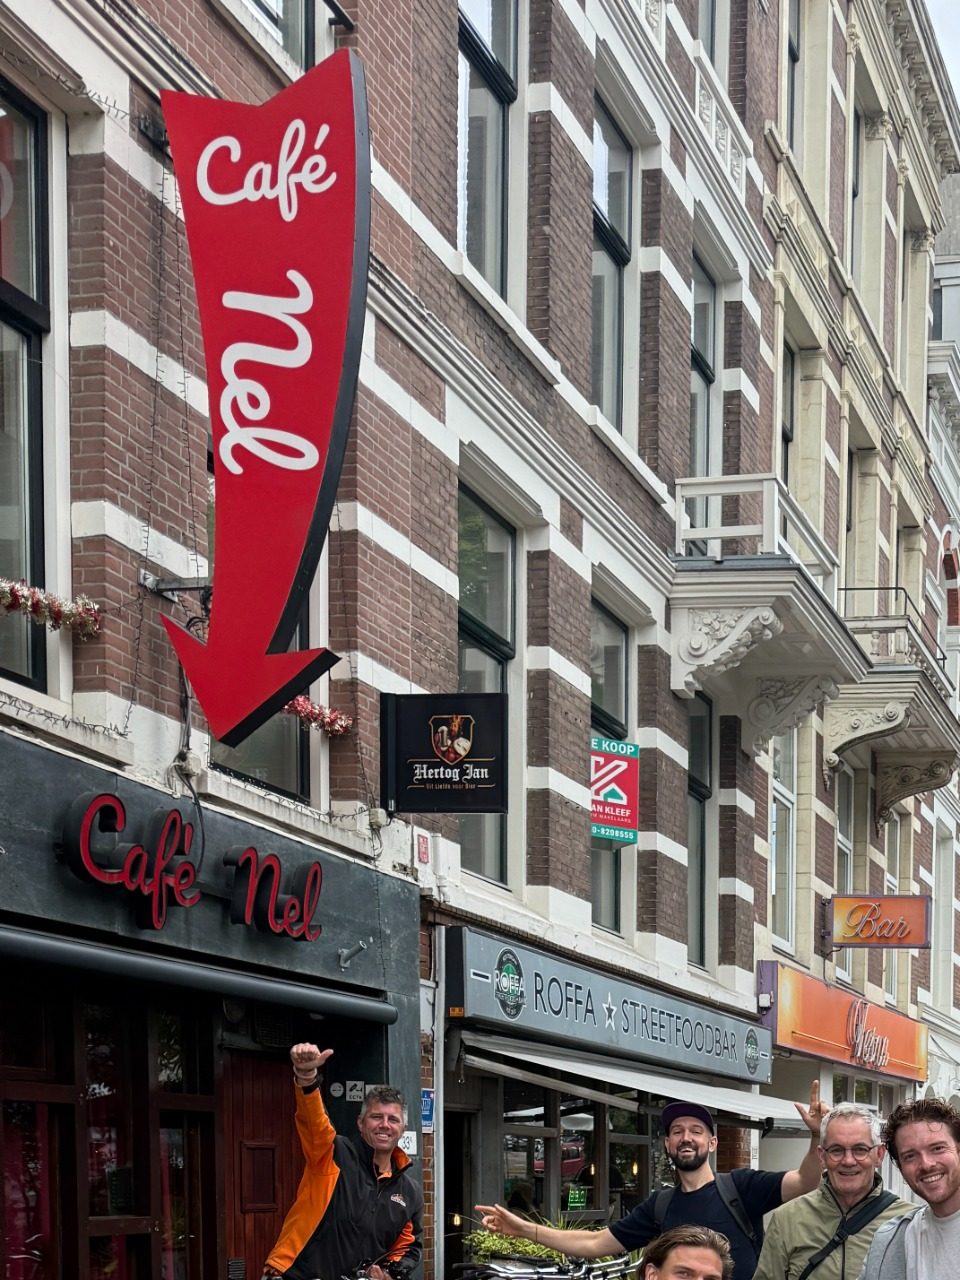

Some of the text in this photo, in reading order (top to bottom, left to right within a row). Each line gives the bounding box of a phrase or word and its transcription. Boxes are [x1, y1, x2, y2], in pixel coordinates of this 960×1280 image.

[196, 118, 337, 222] Café
[590, 738, 635, 755] E KOOP
[413, 764, 489, 784] Hertog Jan
[591, 803, 603, 813] AN
[605, 805, 632, 818] KLEEF
[79, 793, 323, 942] Café Nel
[843, 902, 912, 939] Bar
[534, 970, 739, 1063] ROFFA STREETFOODBAR
